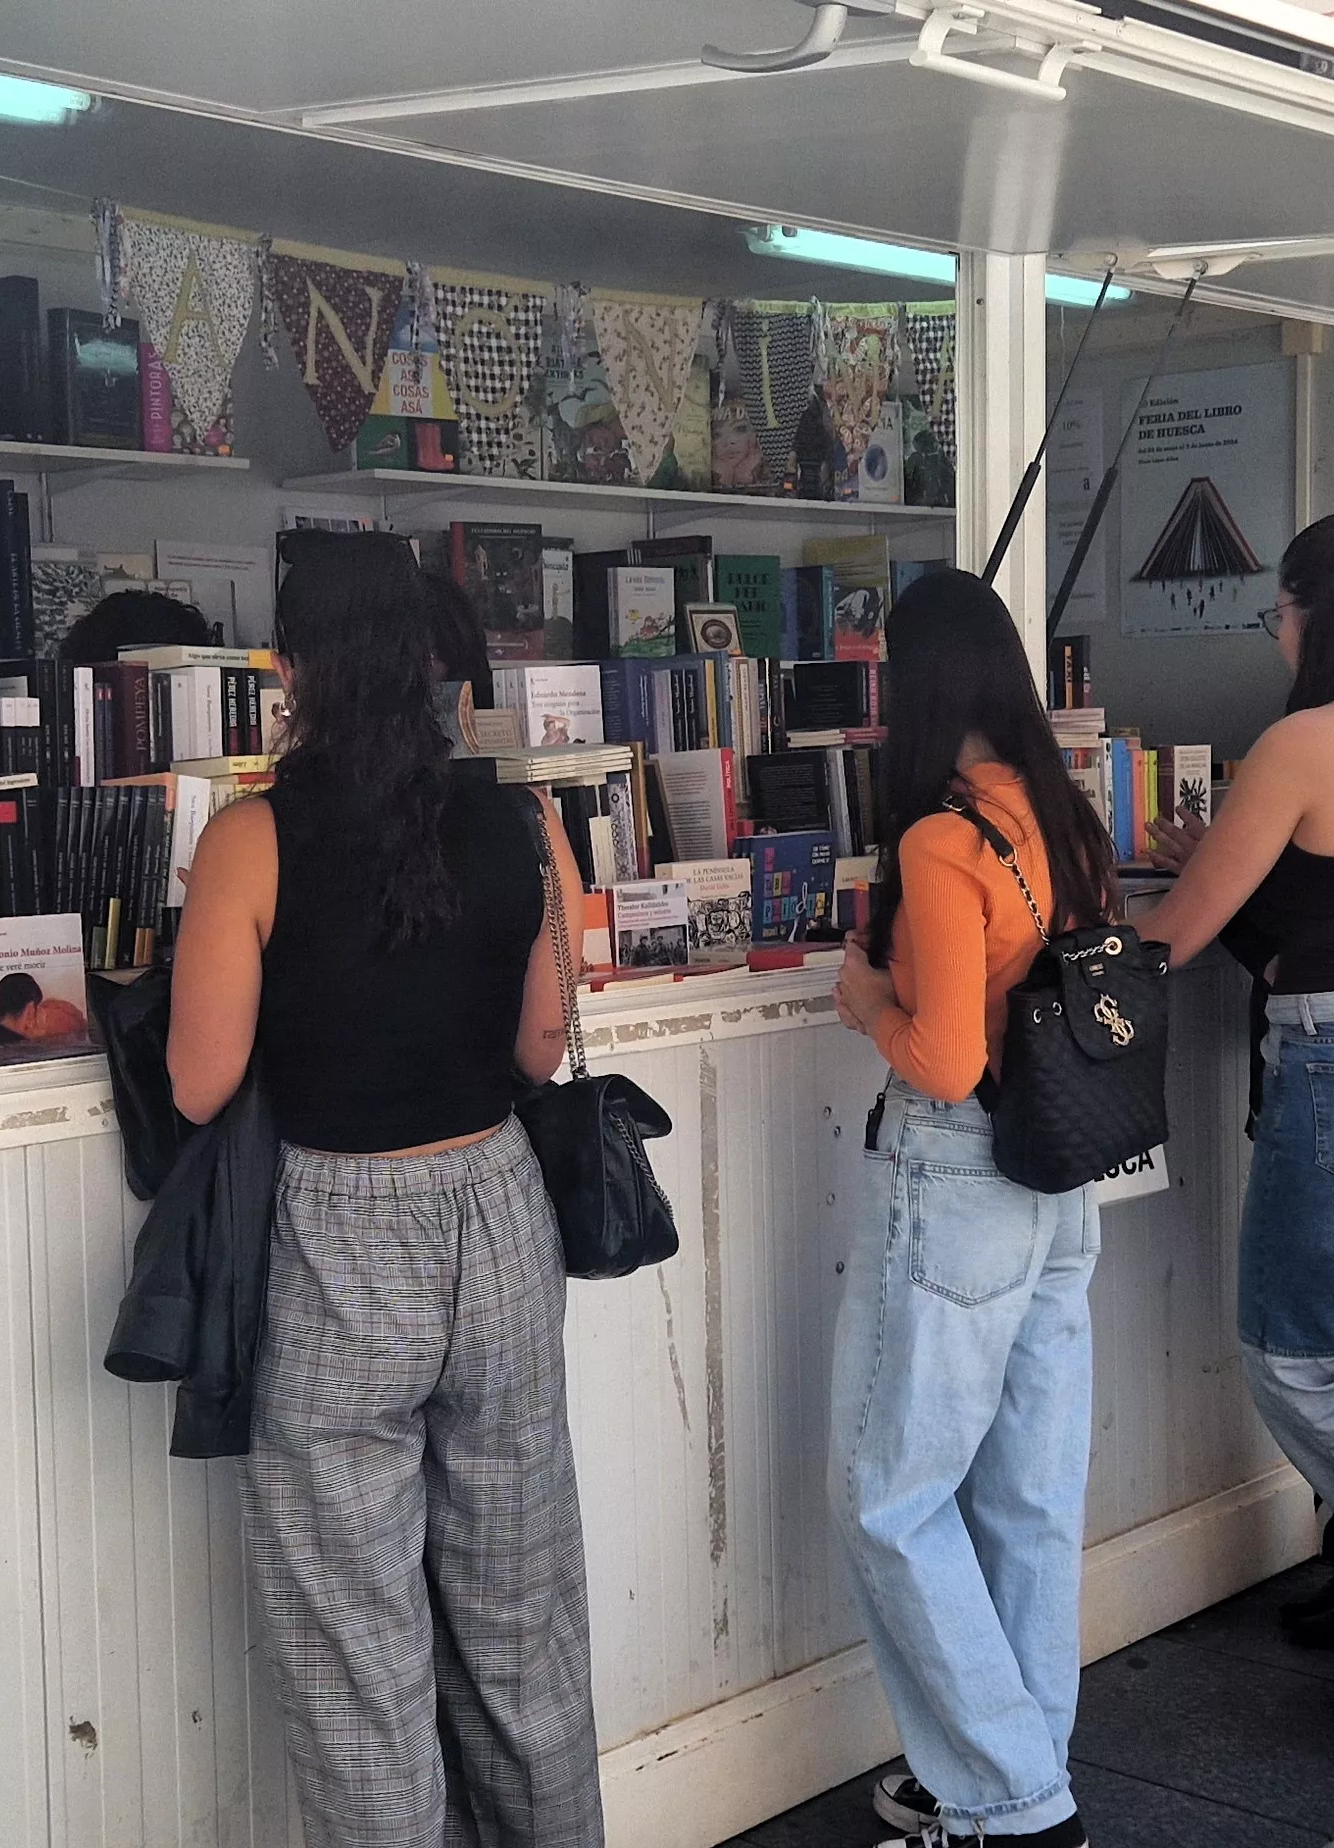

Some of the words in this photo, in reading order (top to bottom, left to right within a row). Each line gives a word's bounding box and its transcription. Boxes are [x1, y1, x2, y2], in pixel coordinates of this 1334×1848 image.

[393, 386, 429, 398] COSAS
[1138, 413, 1175, 426] FERIA
[1178, 410, 1202, 422] DEL
[1204, 405, 1242, 419] LIBRO
[1138, 428, 1155, 440] DE
[1157, 424, 1206, 438] HUESCA
[227, 676, 236, 698] PÉREZ
[248, 675, 256, 697] PÉREZ
[137, 677, 146, 751] POMPEYA
[694, 876, 706, 885] LAS
[707, 874, 725, 883] CASAS
[20, 947, 51, 957] Muñoz
[52, 944, 81, 955] Molina
[4, 960, 22, 971] veré
